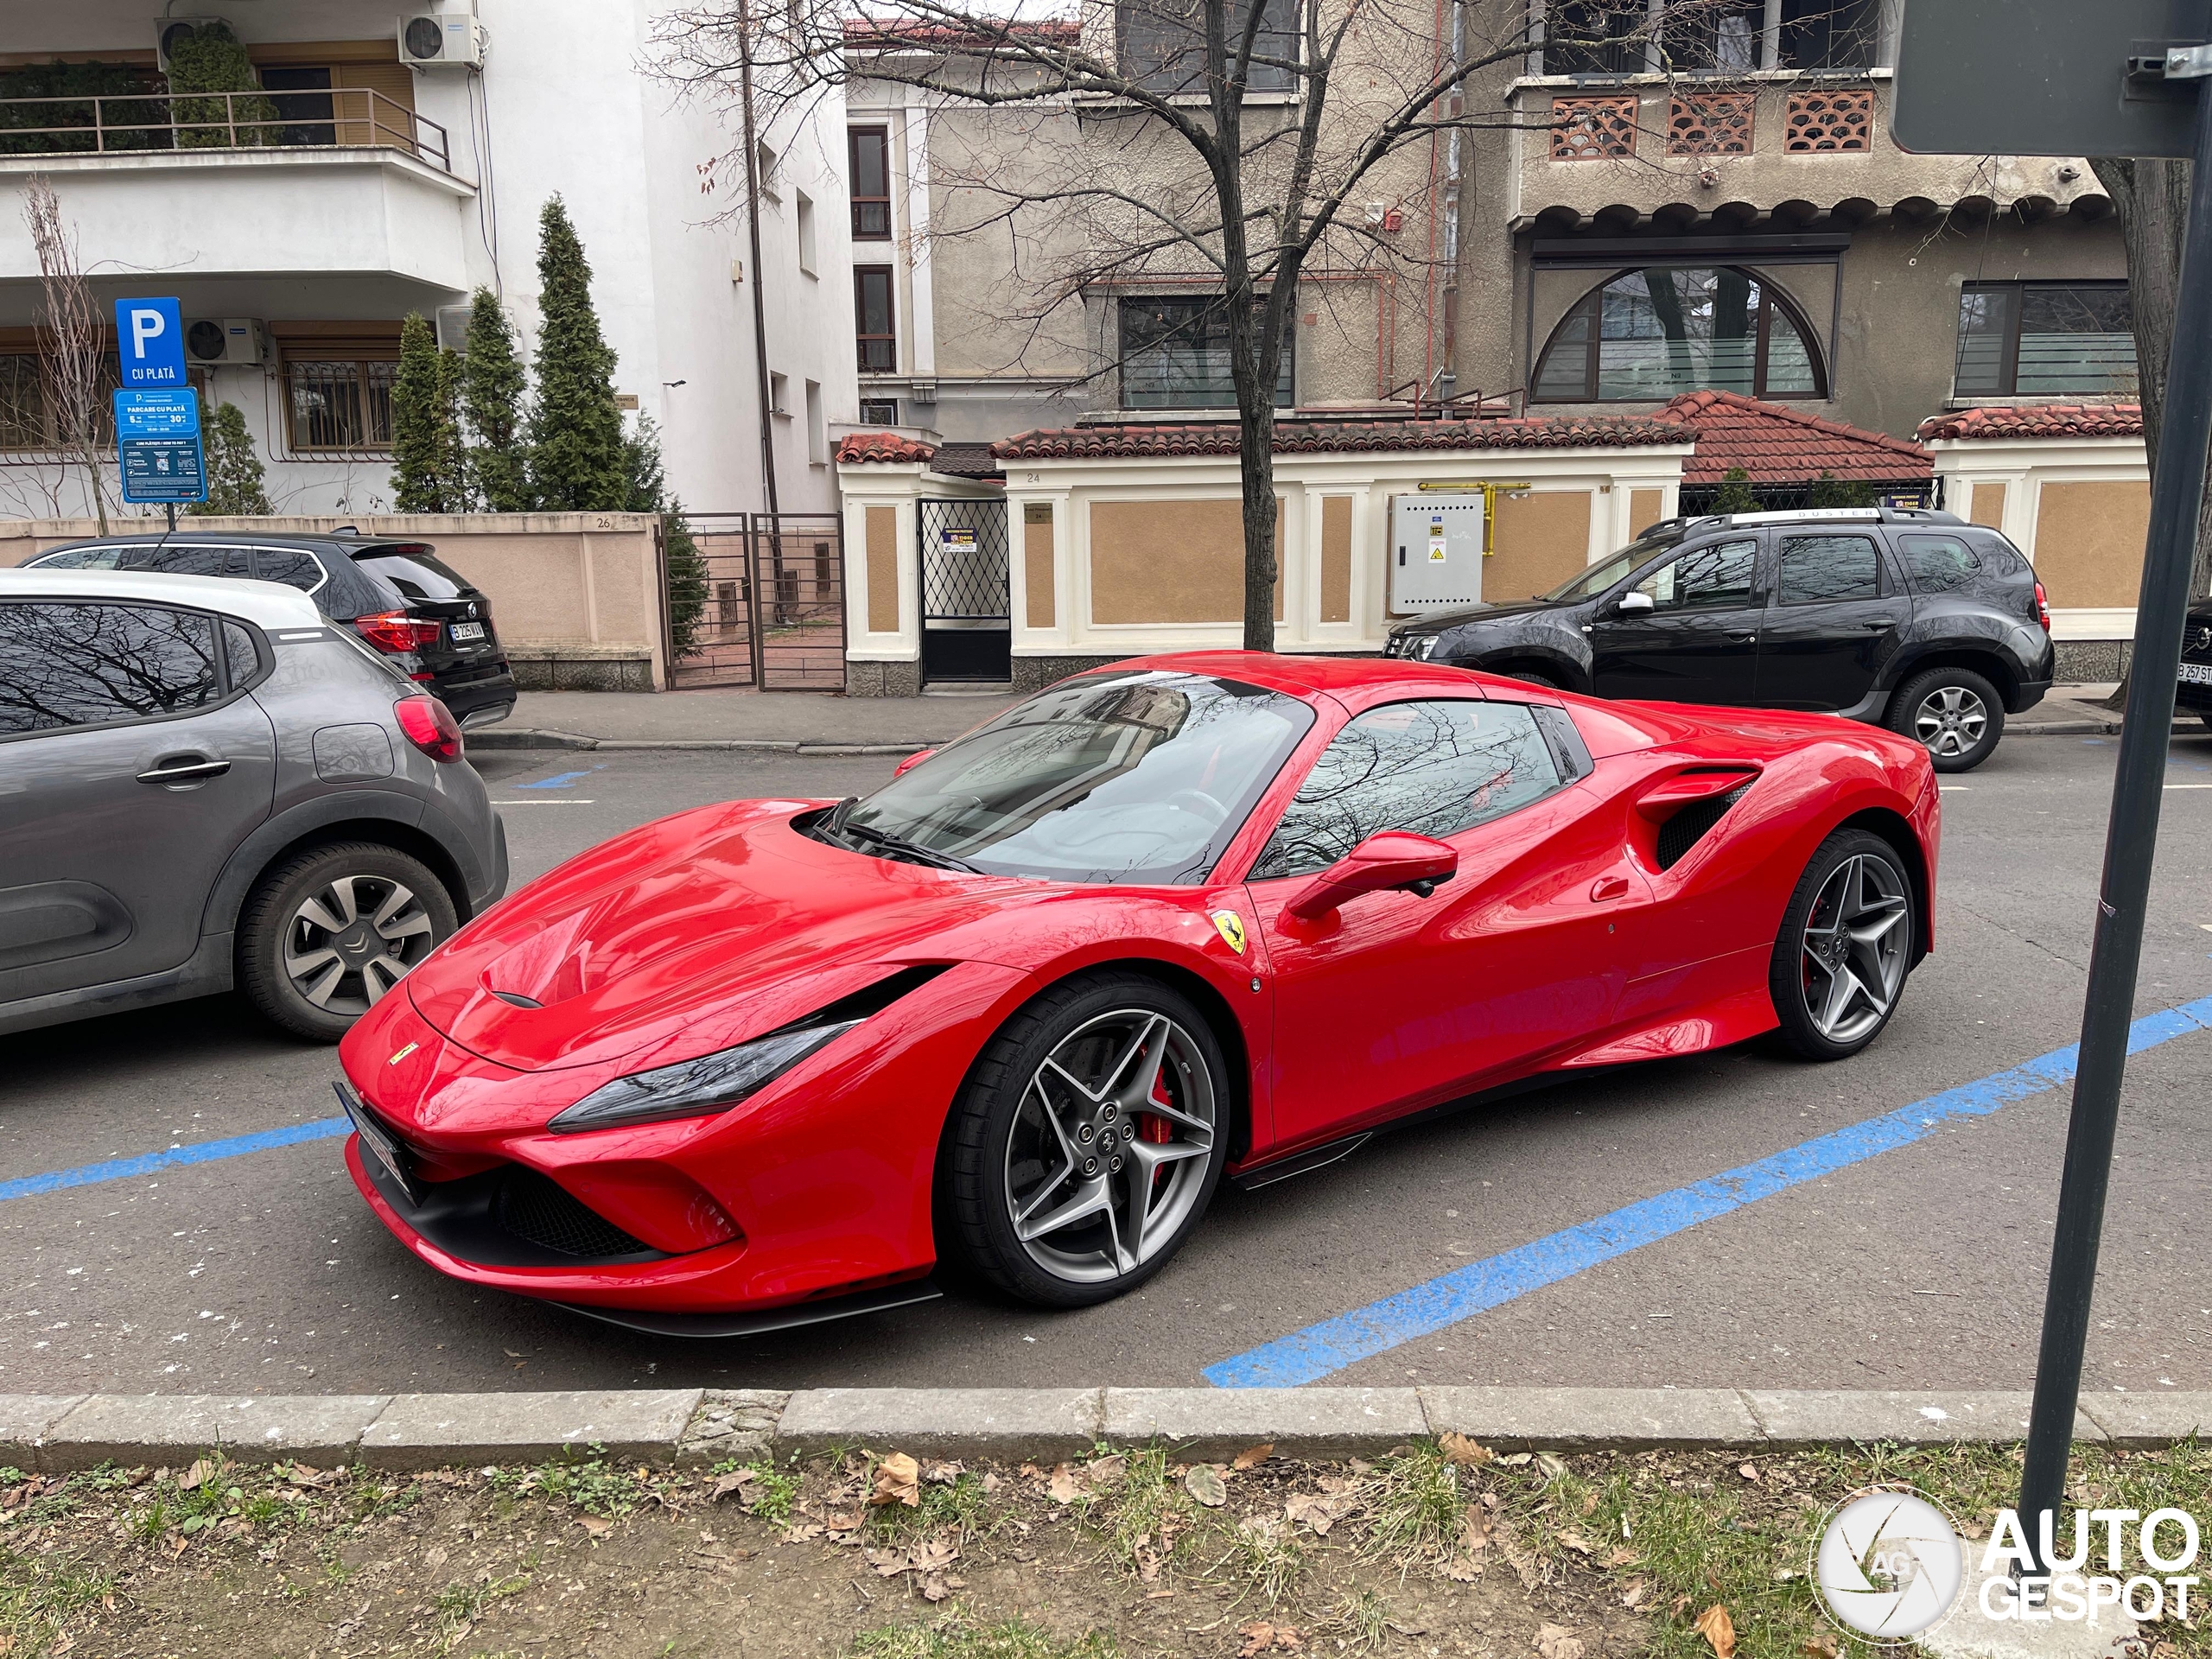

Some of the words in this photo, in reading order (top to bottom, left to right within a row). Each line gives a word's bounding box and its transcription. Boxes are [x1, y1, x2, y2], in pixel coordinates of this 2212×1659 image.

[130, 308, 165, 359] P
[131, 368, 144, 380] CU
[146, 365, 175, 380] PLATĂ
[129, 415, 136, 423] 5
[1027, 473, 1039, 482] 24
[596, 518, 610, 528] 26
[453, 626, 460, 639] B
[2178, 664, 2184, 677] B
[2186, 665, 2200, 678] 257
[2201, 667, 2212, 681] ST
